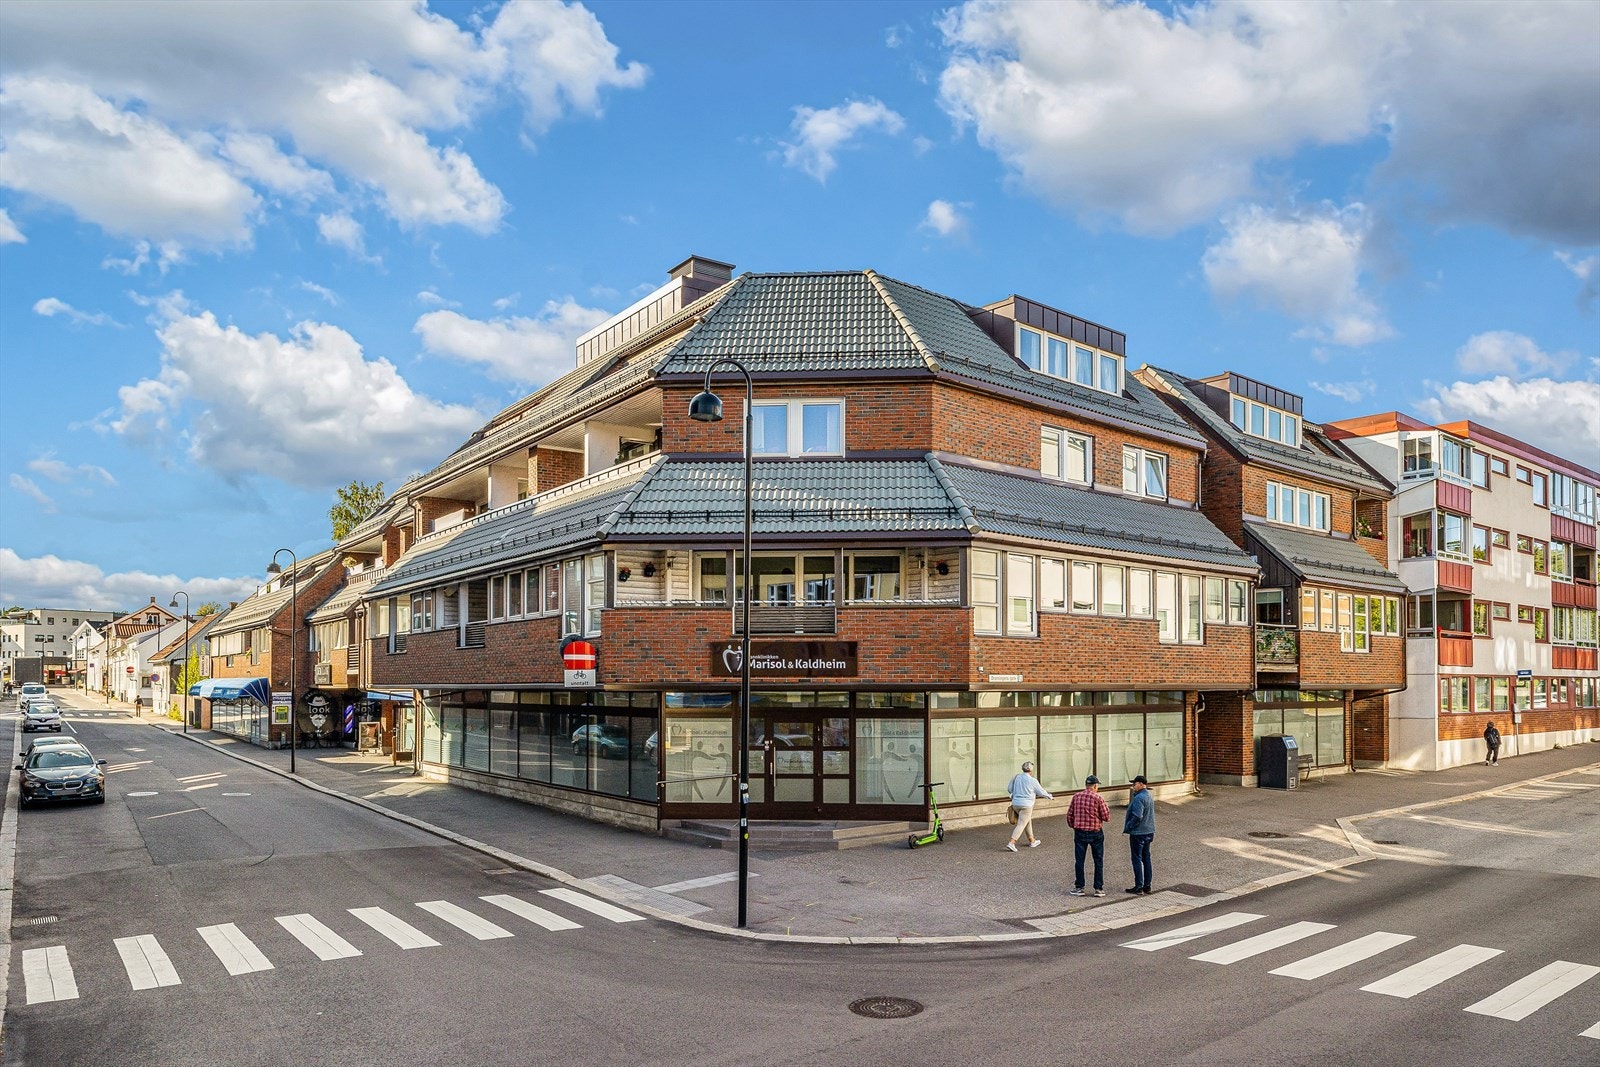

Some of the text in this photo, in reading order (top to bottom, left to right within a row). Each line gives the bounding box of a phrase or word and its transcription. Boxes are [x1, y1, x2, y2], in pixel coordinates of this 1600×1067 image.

[749, 659, 846, 669] Marisol & Kaldheim
[308, 705, 330, 714] look
